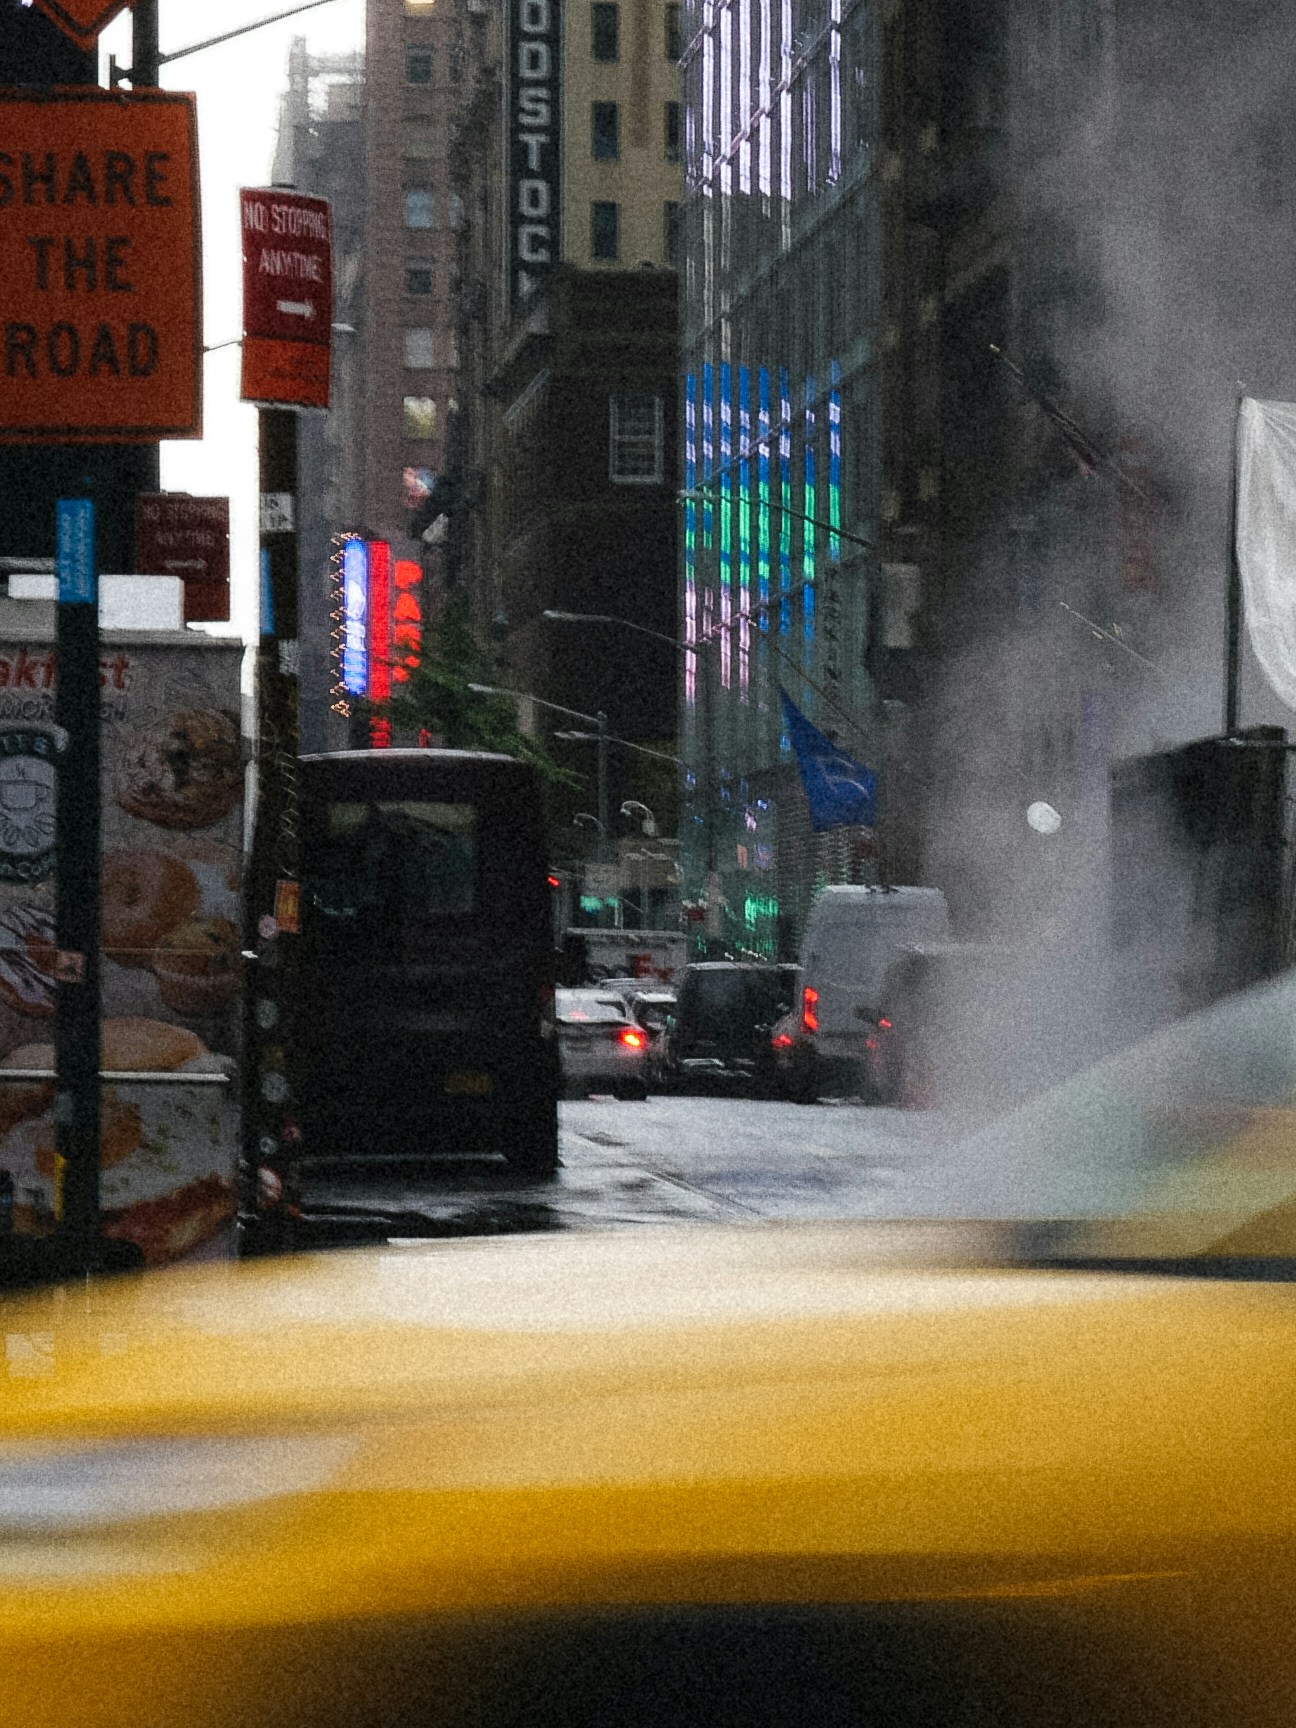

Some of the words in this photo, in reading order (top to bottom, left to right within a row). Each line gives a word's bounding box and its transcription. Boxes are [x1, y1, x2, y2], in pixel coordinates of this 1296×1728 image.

[243, 201, 268, 233] NO
[28, 236, 135, 292] THE
[259, 248, 324, 283] ANYTIME
[6, 322, 159, 378] ROAD
